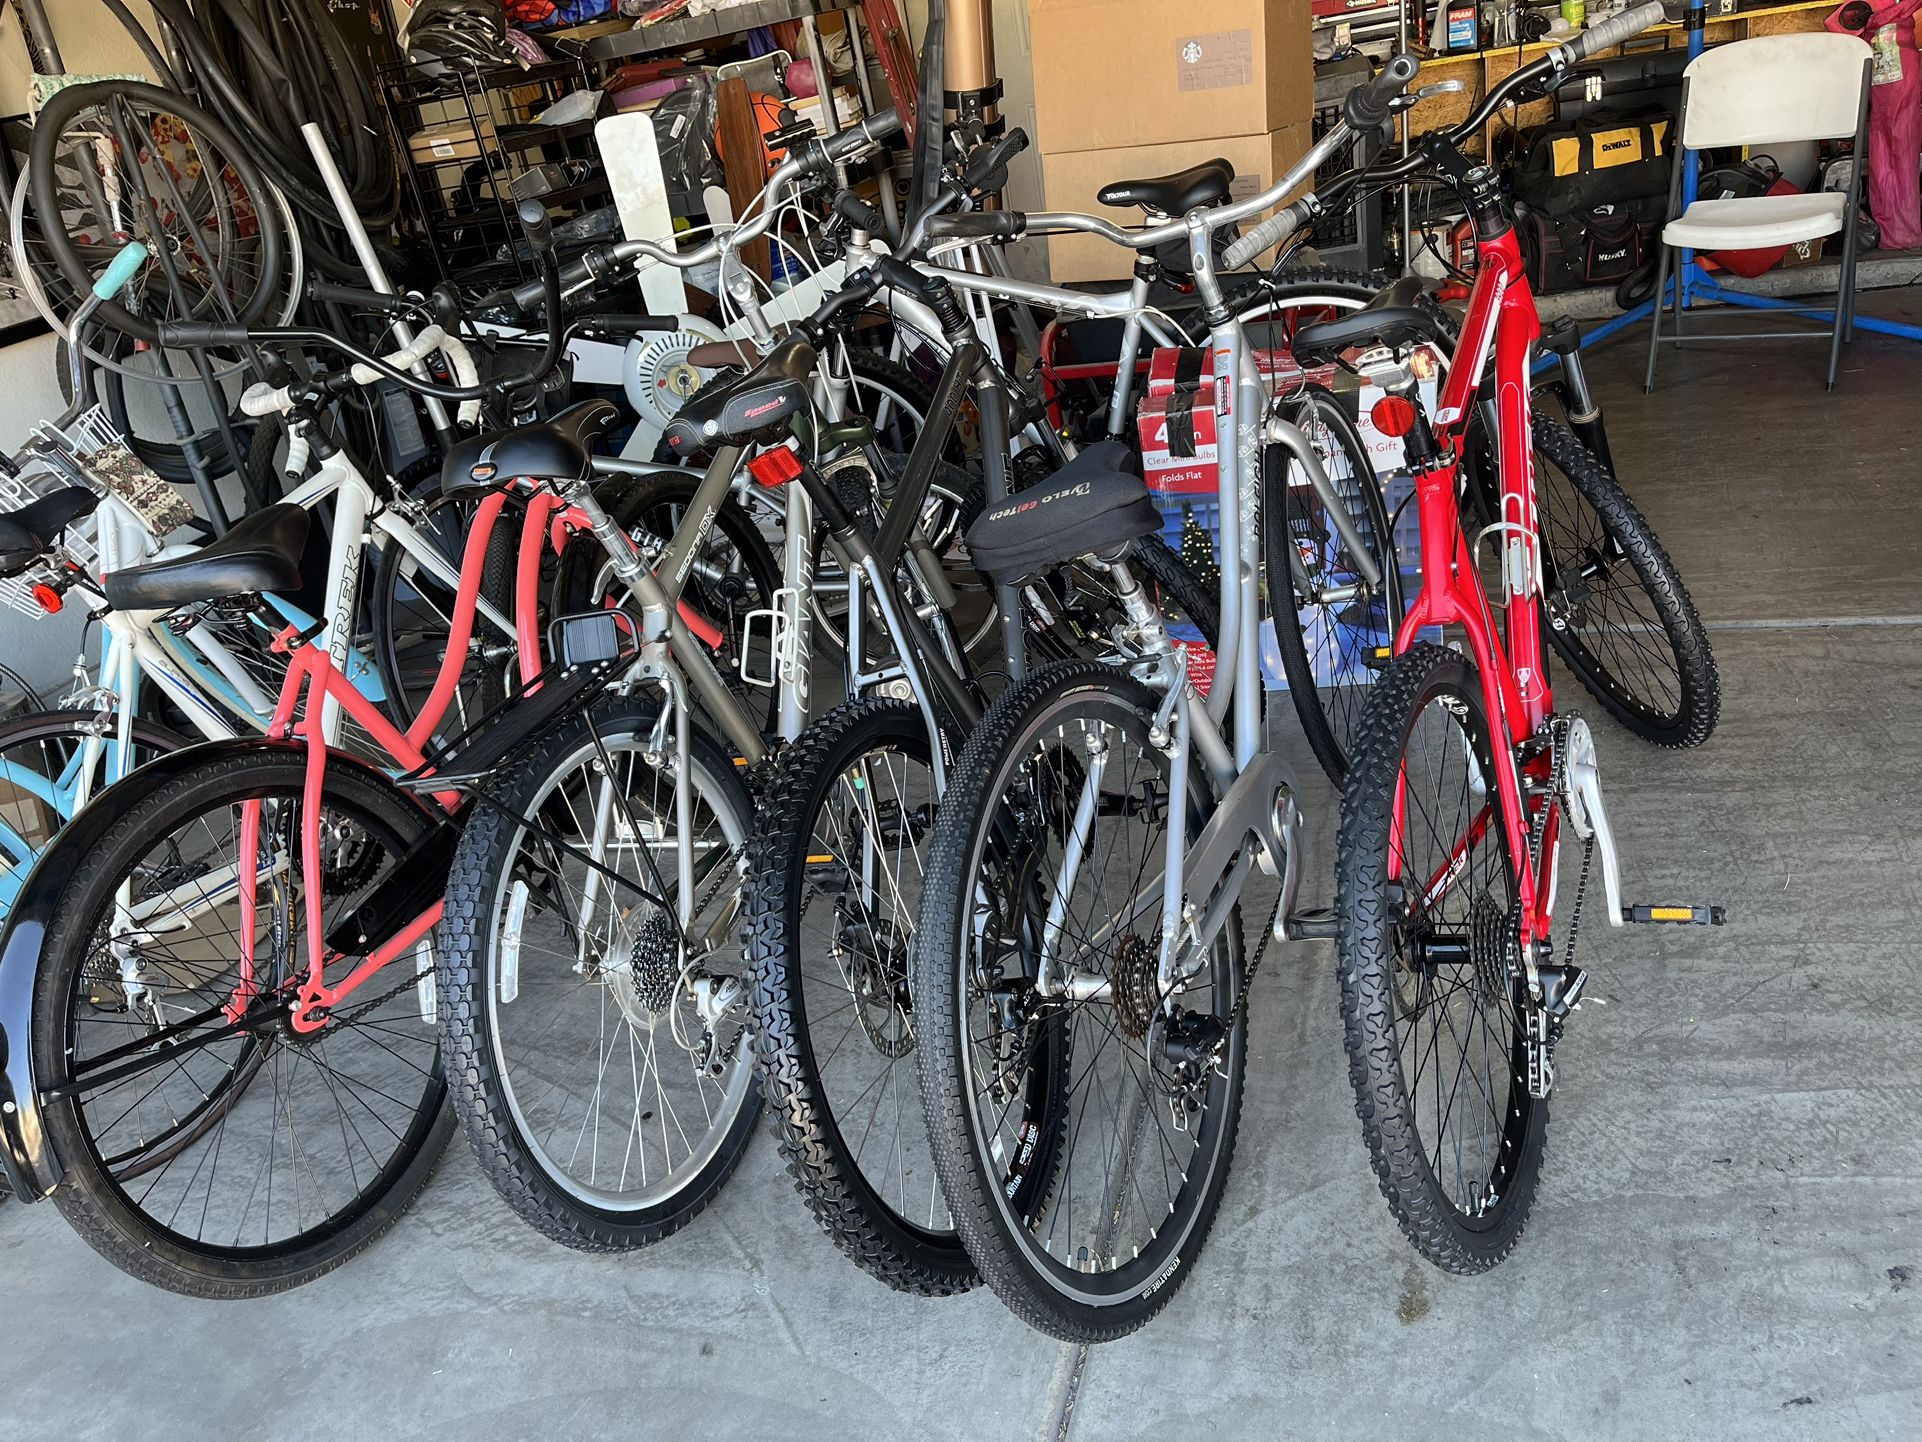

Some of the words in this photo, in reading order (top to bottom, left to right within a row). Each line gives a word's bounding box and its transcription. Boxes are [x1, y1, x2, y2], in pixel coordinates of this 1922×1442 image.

[1449, 10, 1473, 20] FRAM
[1375, 440, 1398, 452] Gift
[1147, 456, 1169, 466] Clear
[1161, 472, 1185, 483] Folds
[1186, 471, 1203, 481] Flat
[675, 531, 704, 584] SEDONA
[699, 504, 716, 536] DX
[330, 544, 360, 677] TREK
[1026, 1124, 1037, 1144] DISC
